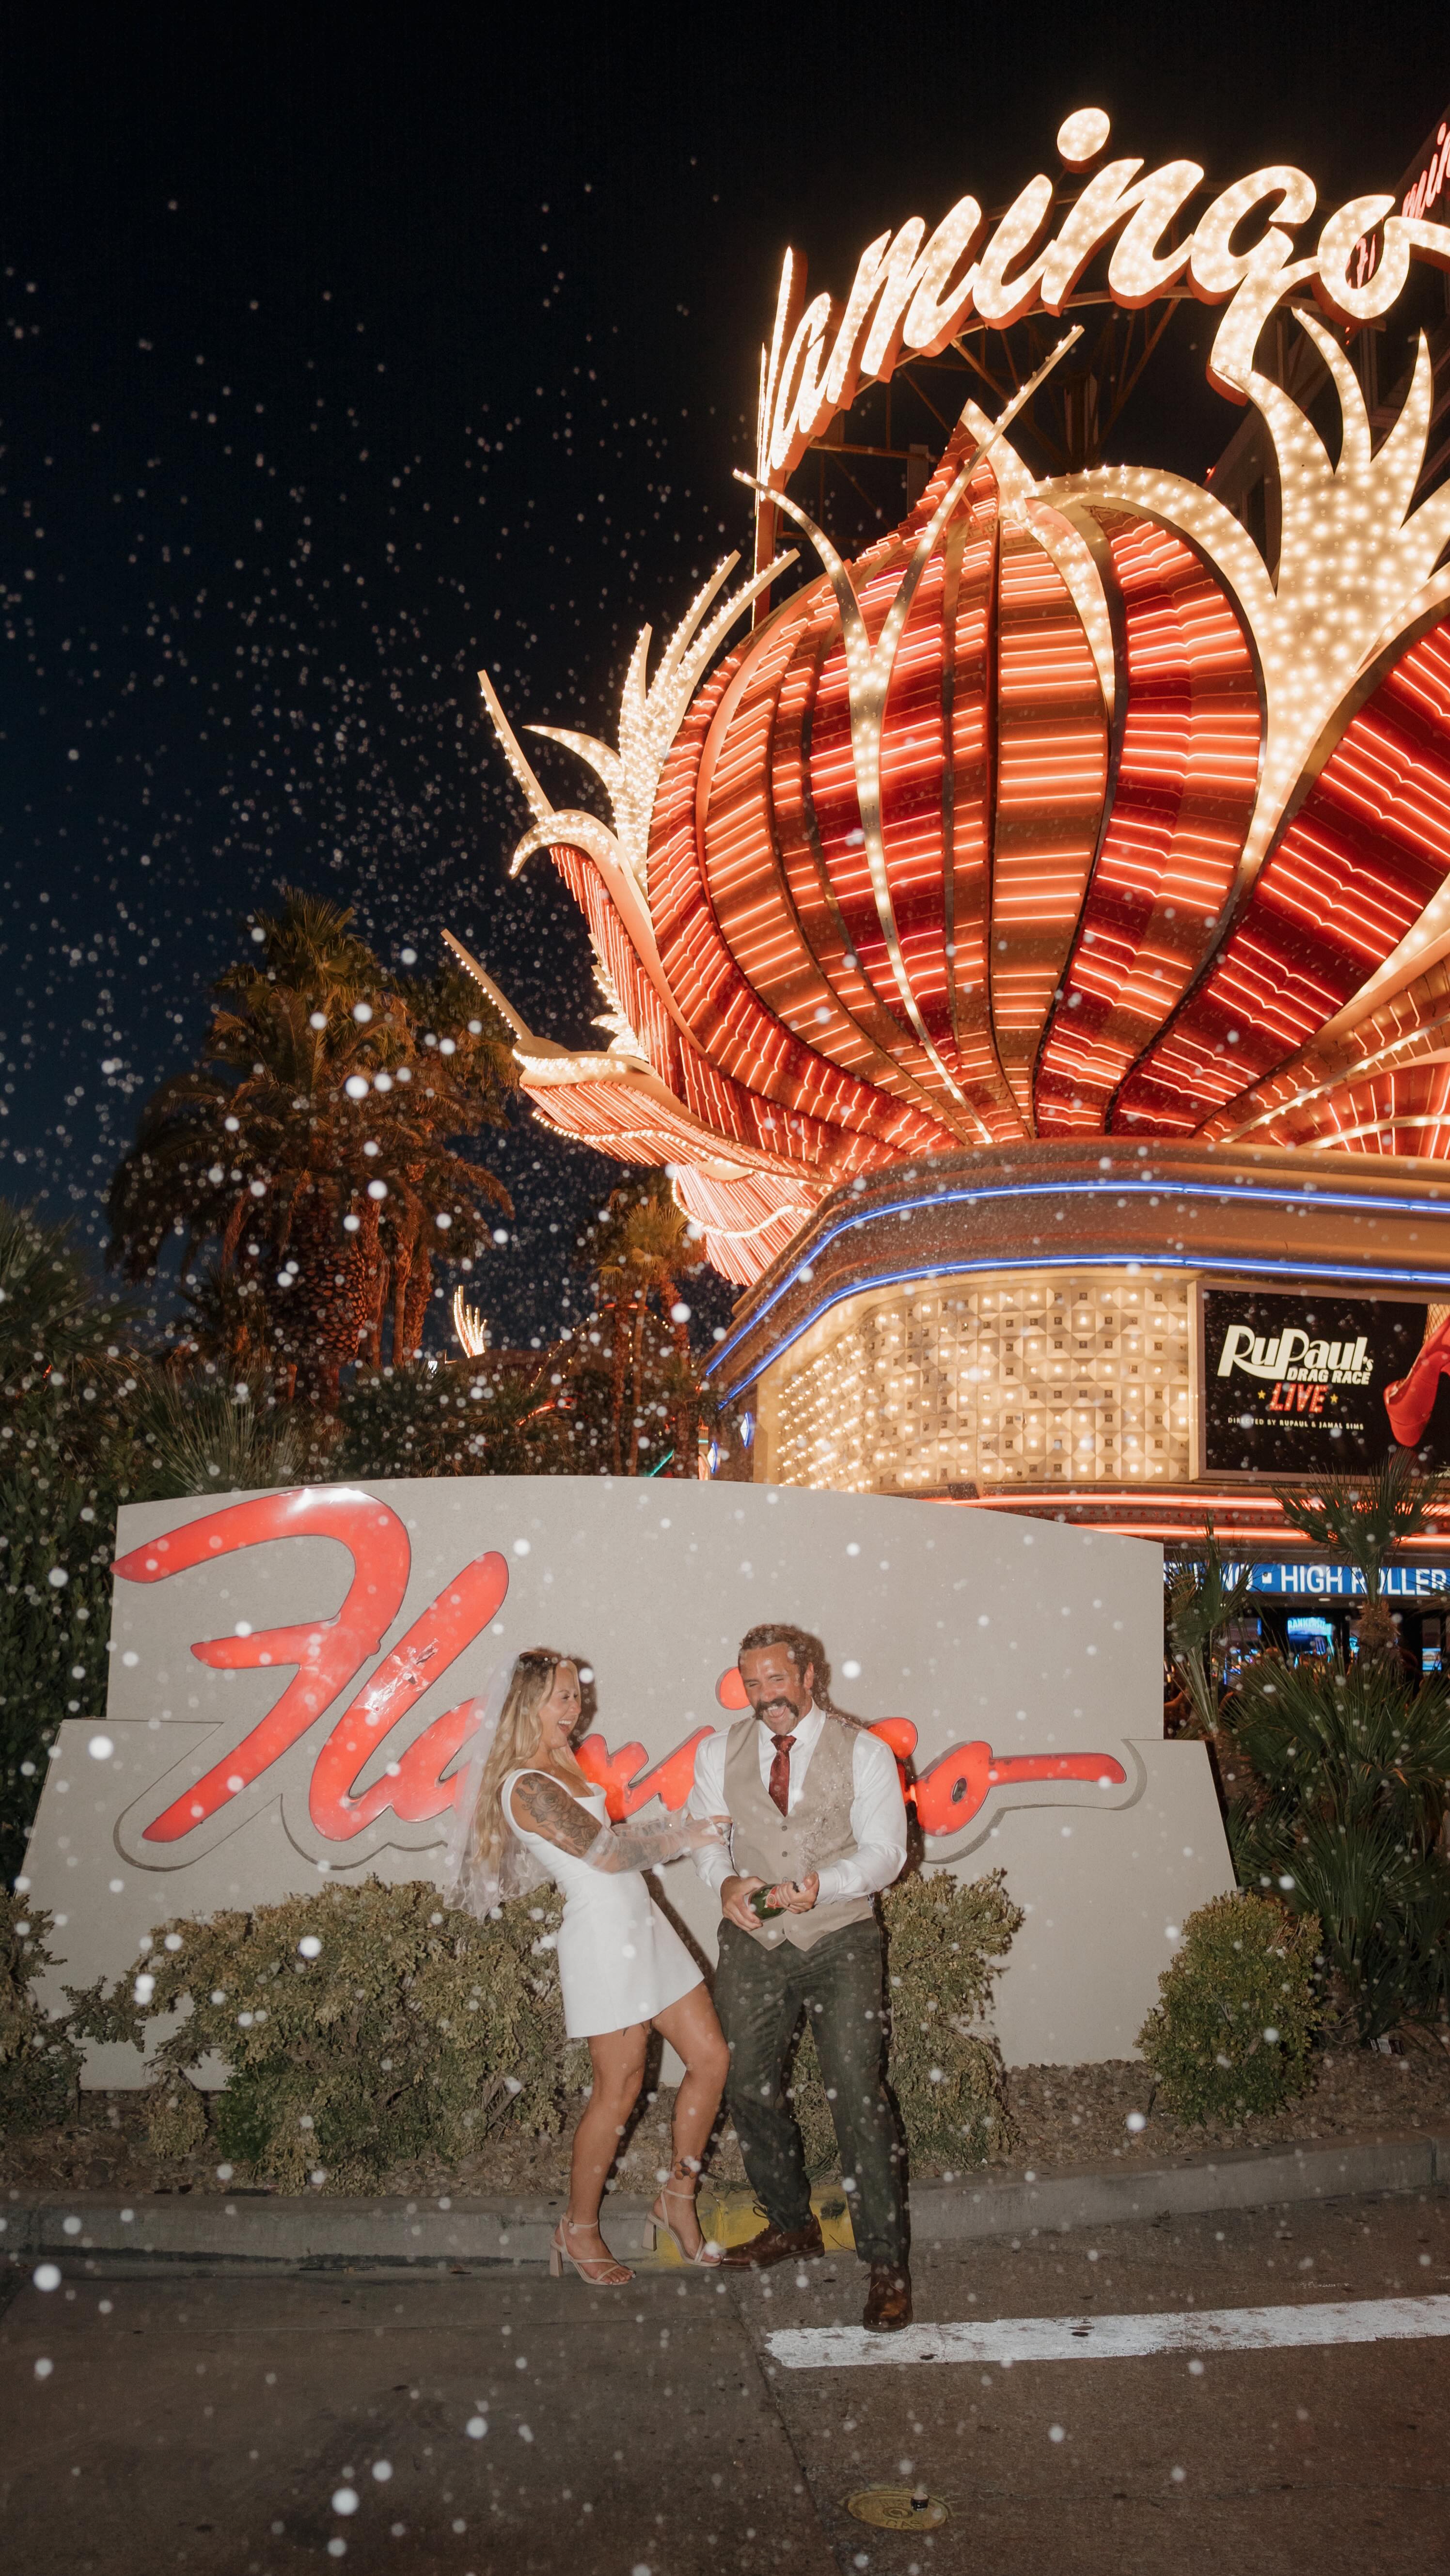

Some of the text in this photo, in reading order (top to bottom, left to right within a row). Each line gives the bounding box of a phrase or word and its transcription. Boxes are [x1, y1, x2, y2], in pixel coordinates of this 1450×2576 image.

[1217, 1324, 1374, 1380] RuPaul's
[1286, 1367, 1371, 1385] DRAG RACE
[1269, 1382, 1329, 1414] LIVE
[1228, 1416, 1264, 1425] DIRECTED
[1279, 1419, 1308, 1428] RUPAUL
[1319, 1421, 1343, 1429] JAMAL
[1281, 1564, 1343, 1594] HIGH
